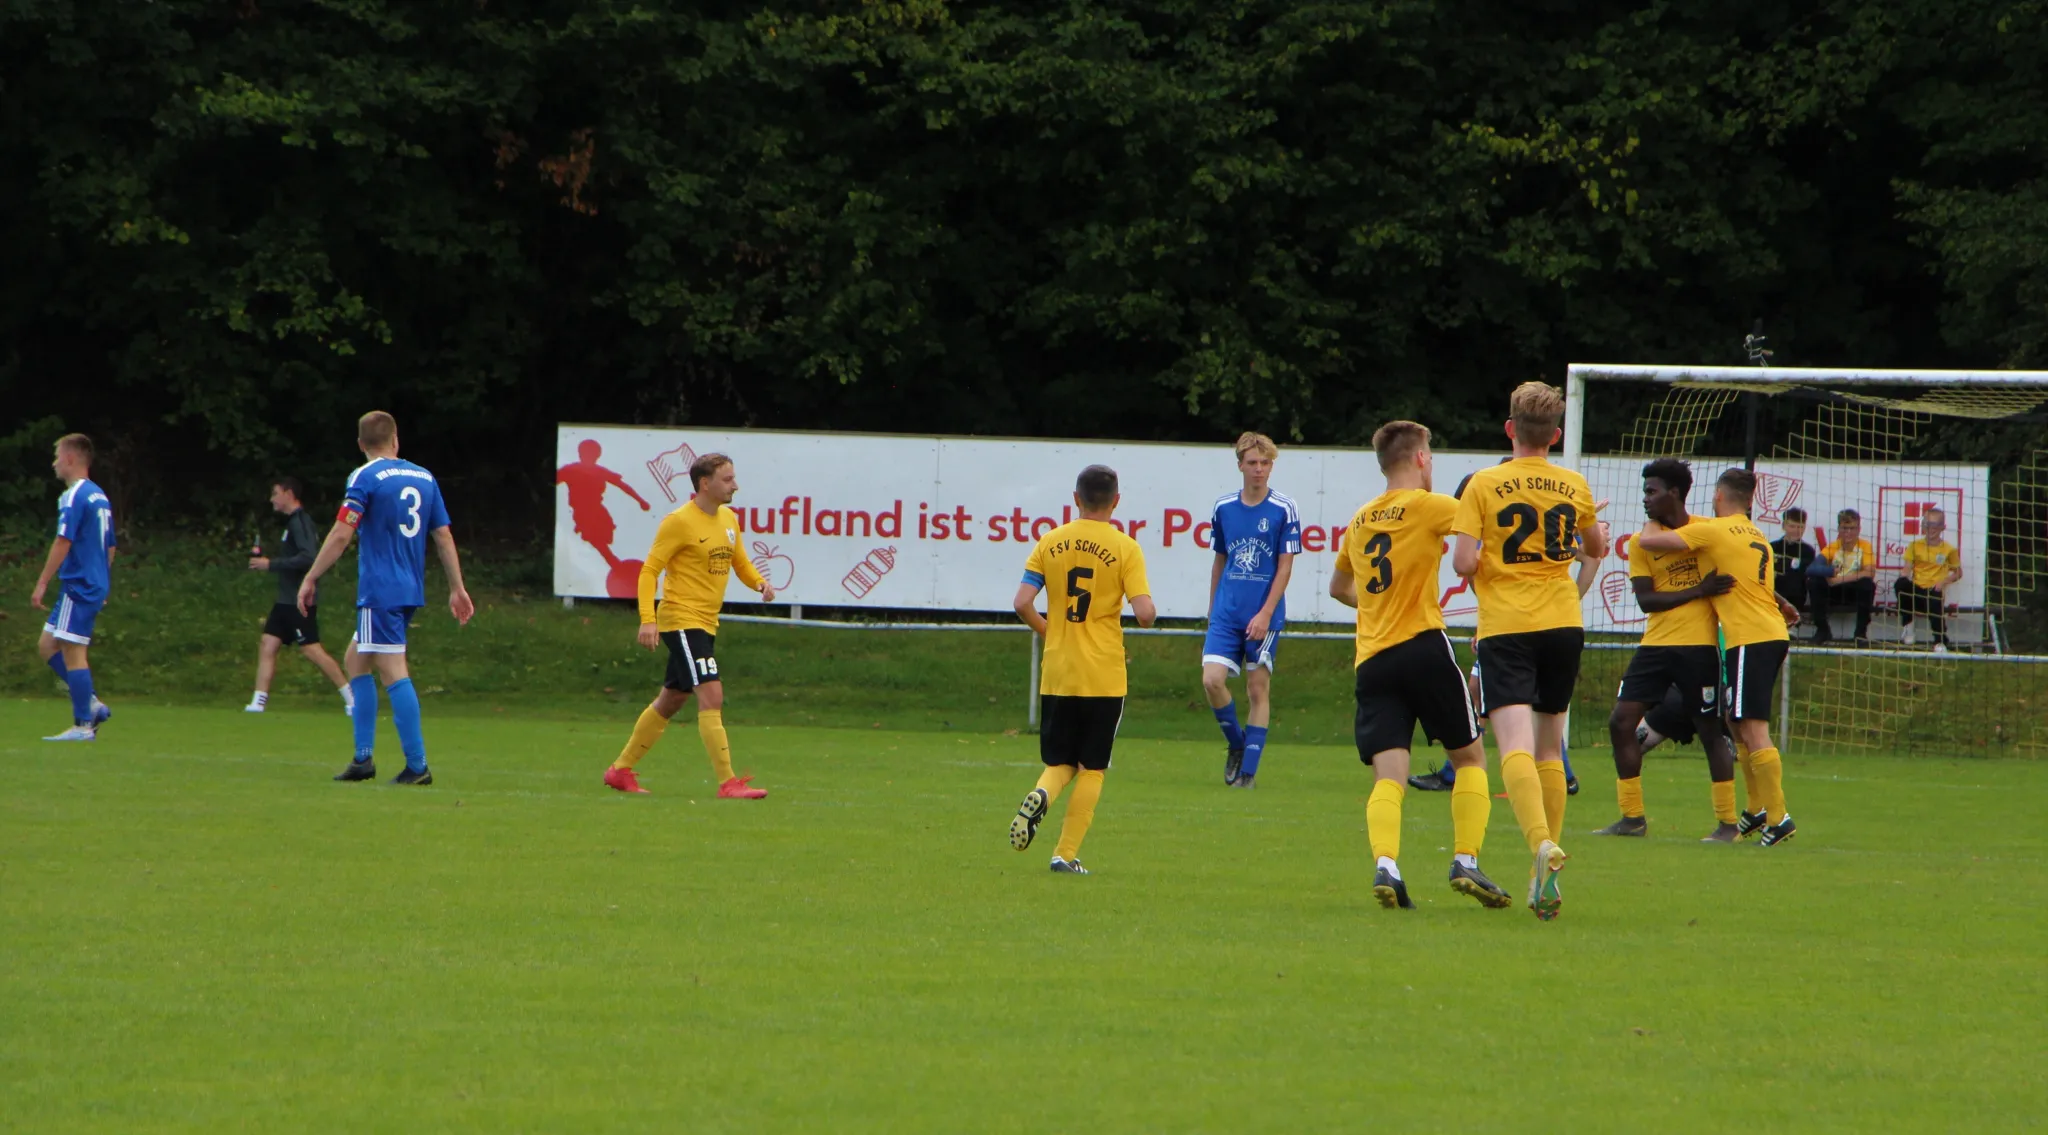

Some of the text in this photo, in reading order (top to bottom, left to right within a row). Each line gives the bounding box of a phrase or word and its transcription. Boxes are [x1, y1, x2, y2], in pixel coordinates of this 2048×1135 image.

[399, 486, 421, 538] 3
[1495, 477, 1576, 500] FSV SCHLEIZ
[918, 502, 973, 541] ist
[1163, 508, 1348, 552] Paer
[1497, 503, 1578, 564] 20
[1050, 539, 1117, 567] FSV SCHLEIZ
[1364, 533, 1392, 594] 3
[1749, 541, 1770, 586] 7
[1066, 566, 1094, 623] 5
[696, 657, 718, 676] 19
